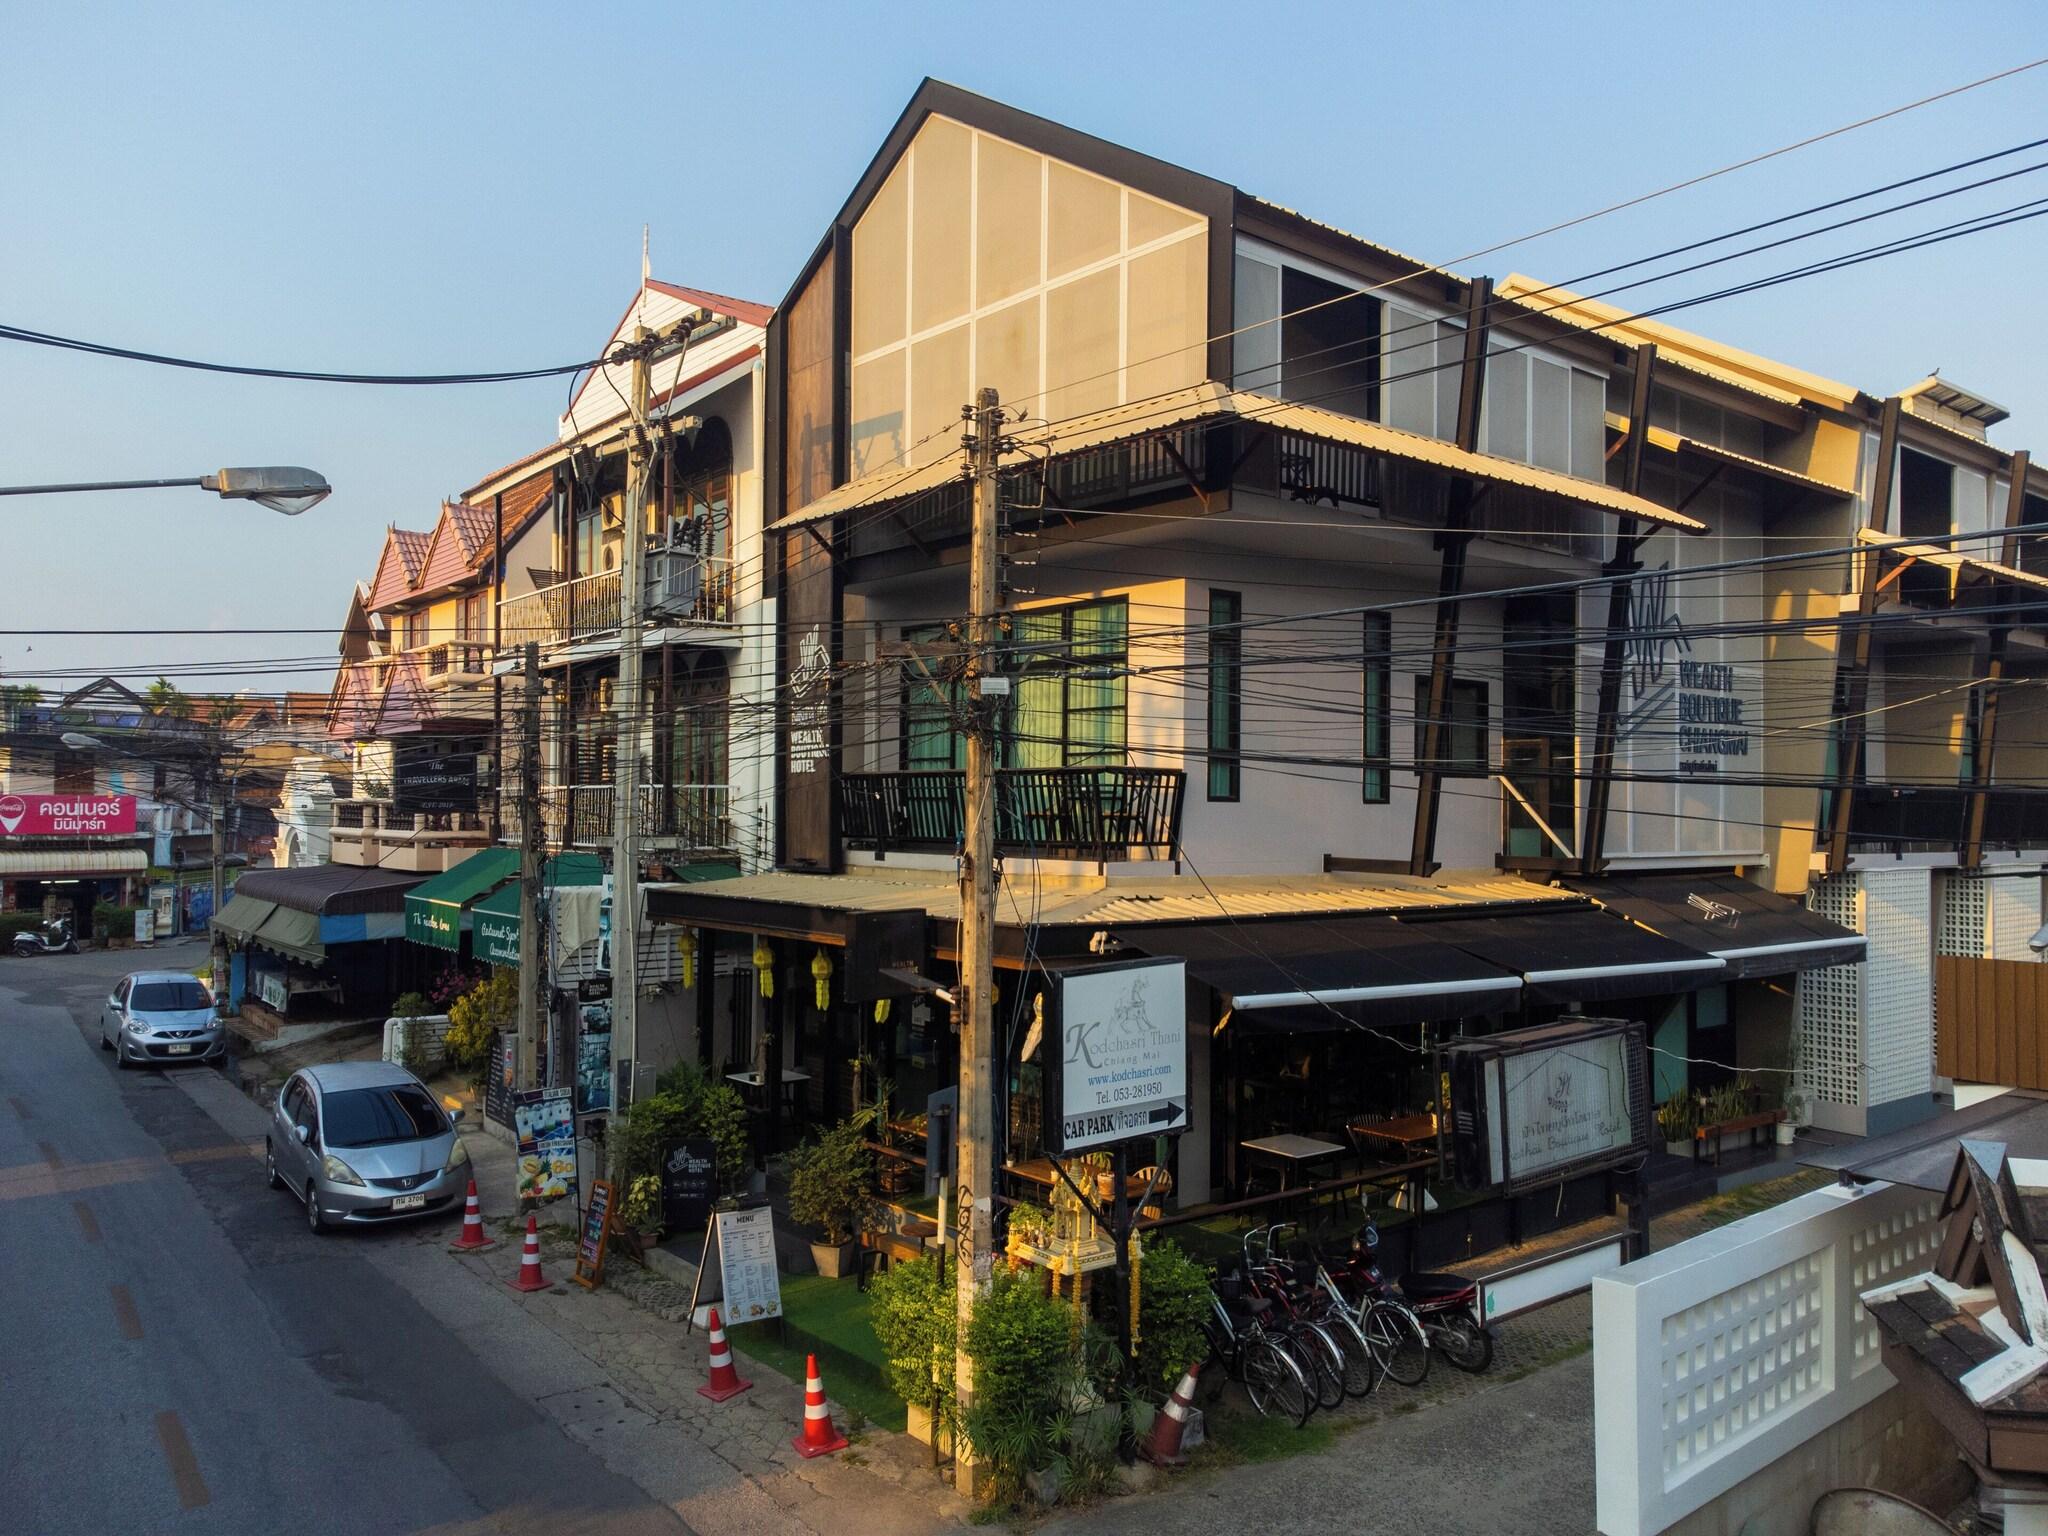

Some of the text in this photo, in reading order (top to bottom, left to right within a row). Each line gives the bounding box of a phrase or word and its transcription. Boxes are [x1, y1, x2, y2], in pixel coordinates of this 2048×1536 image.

[1679, 660, 1733, 692] WEALTH
[1679, 693, 1743, 724] BOUTIQUE
[790, 729, 823, 744] WEALTH
[790, 759, 816, 773] HOTEL
[40, 798, 120, 816] คอนเนอร์
[54, 817, 106, 831] มินิมาร์ท
[1064, 1022, 1181, 1069] Kodchasri Thani
[1103, 1055, 1138, 1066] Chiang
[1088, 1065, 1172, 1087] www.kodchasri.com
[1096, 1081, 1162, 1105] Tel. 053-281950
[1064, 1119, 1085, 1140] CAR
[736, 1215, 754, 1224] MENU
